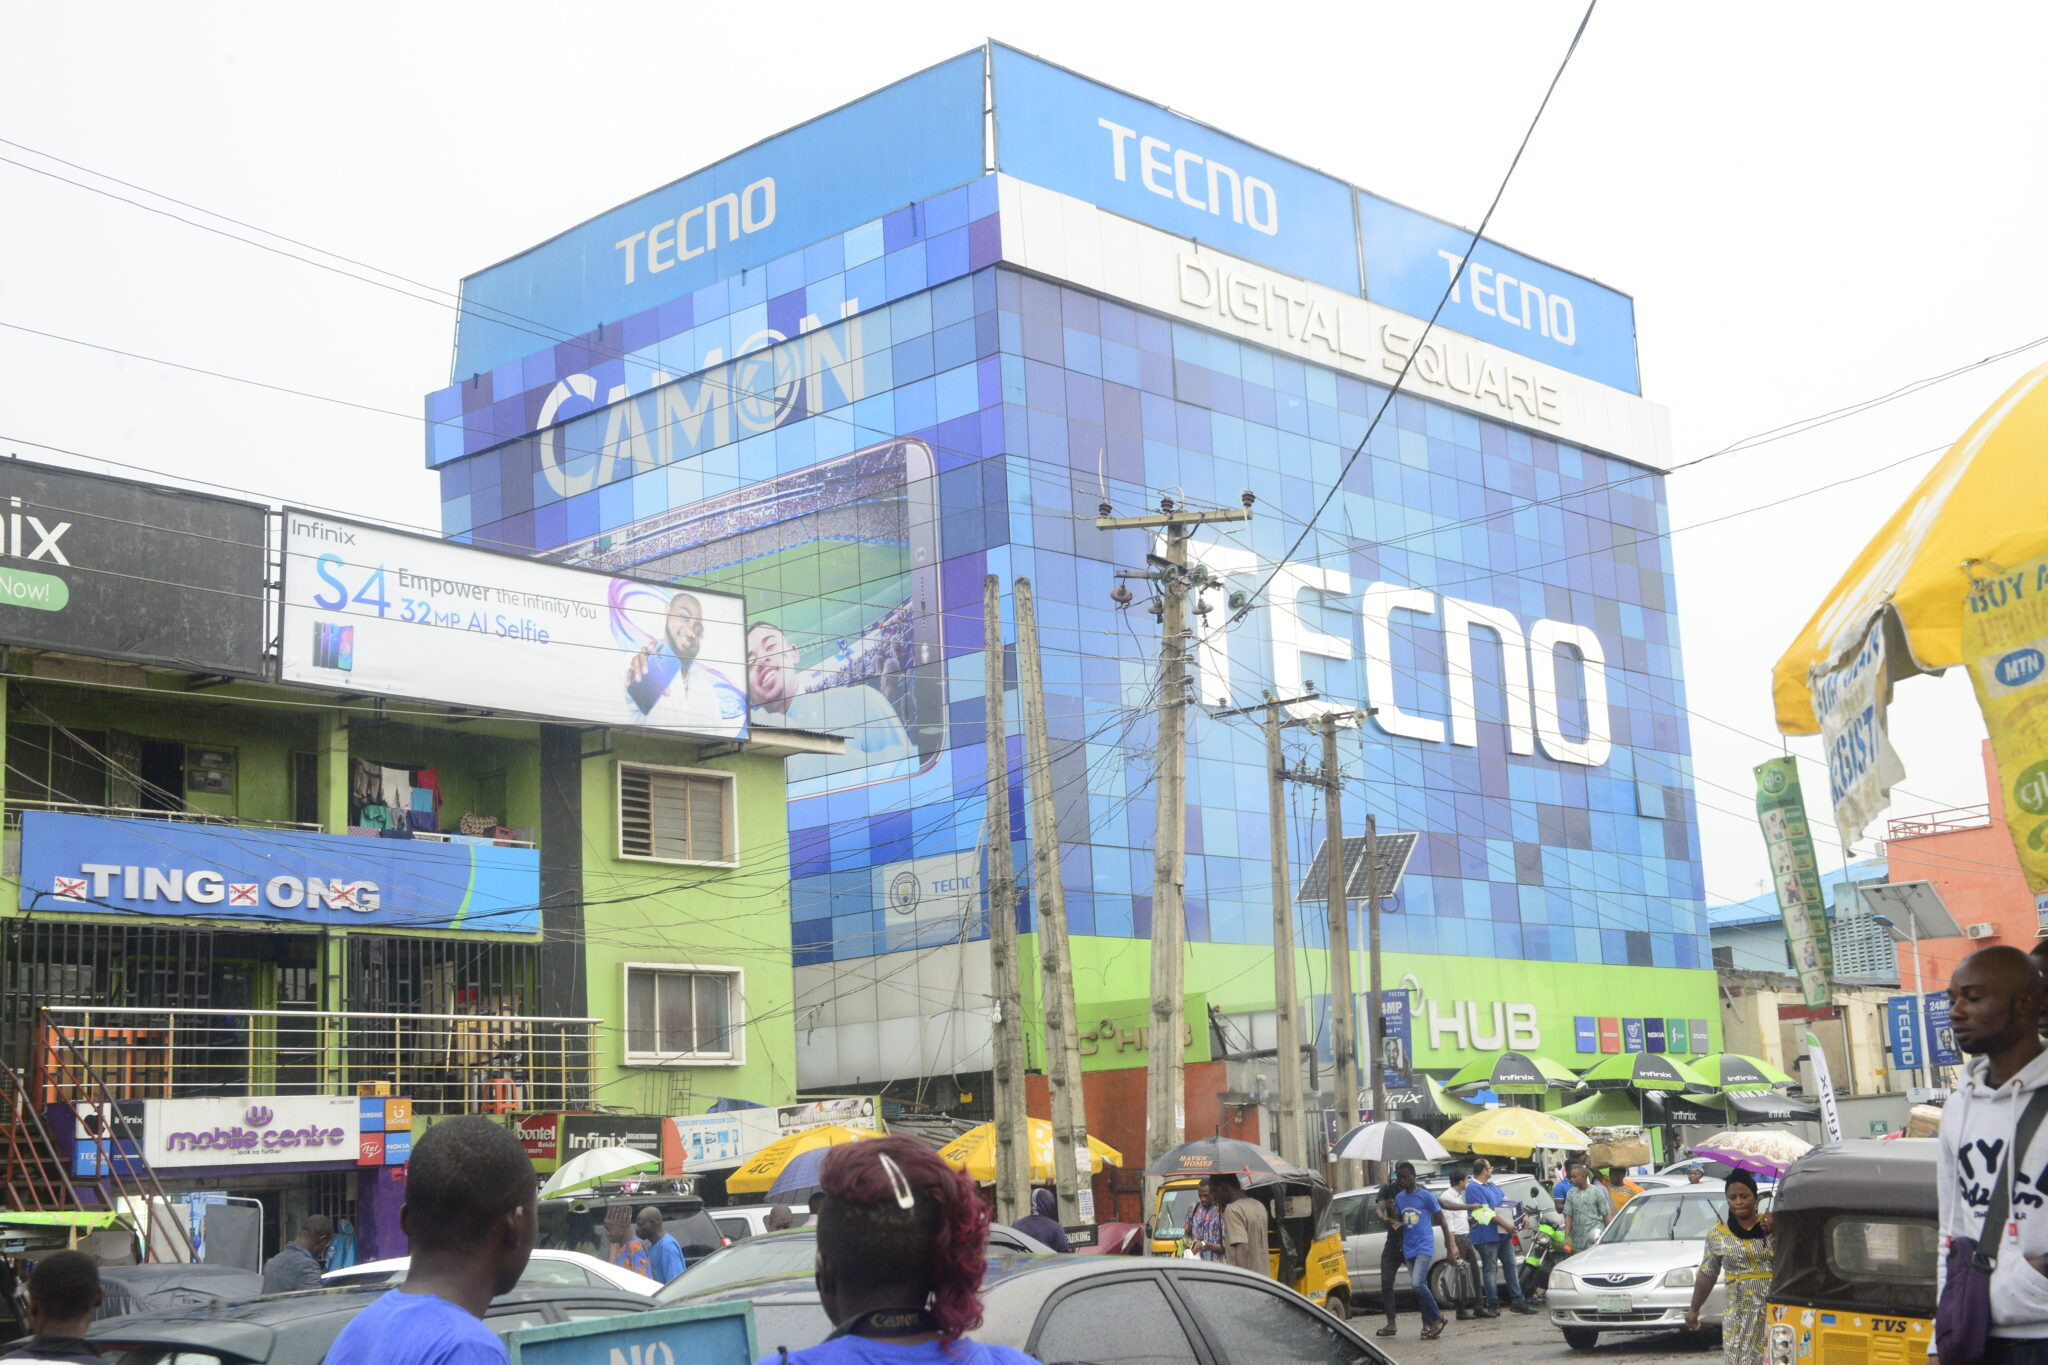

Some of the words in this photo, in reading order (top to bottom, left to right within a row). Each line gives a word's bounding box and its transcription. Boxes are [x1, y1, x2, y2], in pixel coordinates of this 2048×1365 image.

[1098, 117, 1279, 236] TECNO
[615, 176, 777, 285] TECNO
[1437, 250, 1577, 346] TECNO
[1177, 252, 1367, 362] DIGITAL
[1382, 323, 1562, 426] SQUARE
[537, 297, 865, 499] CAMON
[292, 519, 357, 547] Infinix
[312, 552, 392, 619] S4
[398, 567, 491, 602] Empower
[496, 588, 520, 607] the
[522, 592, 571, 618] Infinity
[572, 600, 598, 620] You
[495, 612, 550, 645] Selfie
[1156, 533, 1612, 768] TECNO
[2003, 652, 2040, 682] MTN
[2020, 770, 2048, 810] gl
[80, 863, 226, 904] TING
[265, 875, 381, 913] ONG
[1427, 1000, 1541, 1051] HUB
[1896, 1000, 1915, 1066] TECNO
[1639, 1071, 1672, 1079] Infinix
[1727, 1074, 1760, 1082] Infinix
[166, 1126, 260, 1151] mobile
[261, 1124, 345, 1149] centre
[261, 1148, 282, 1156] further
[568, 1132, 628, 1149] Infinix
[1183, 1159, 1213, 1168] HOMES
[1065, 1230, 1091, 1245] PARKING
[870, 1310, 919, 1330] Canon
[1871, 1317, 1908, 1333] TVS
